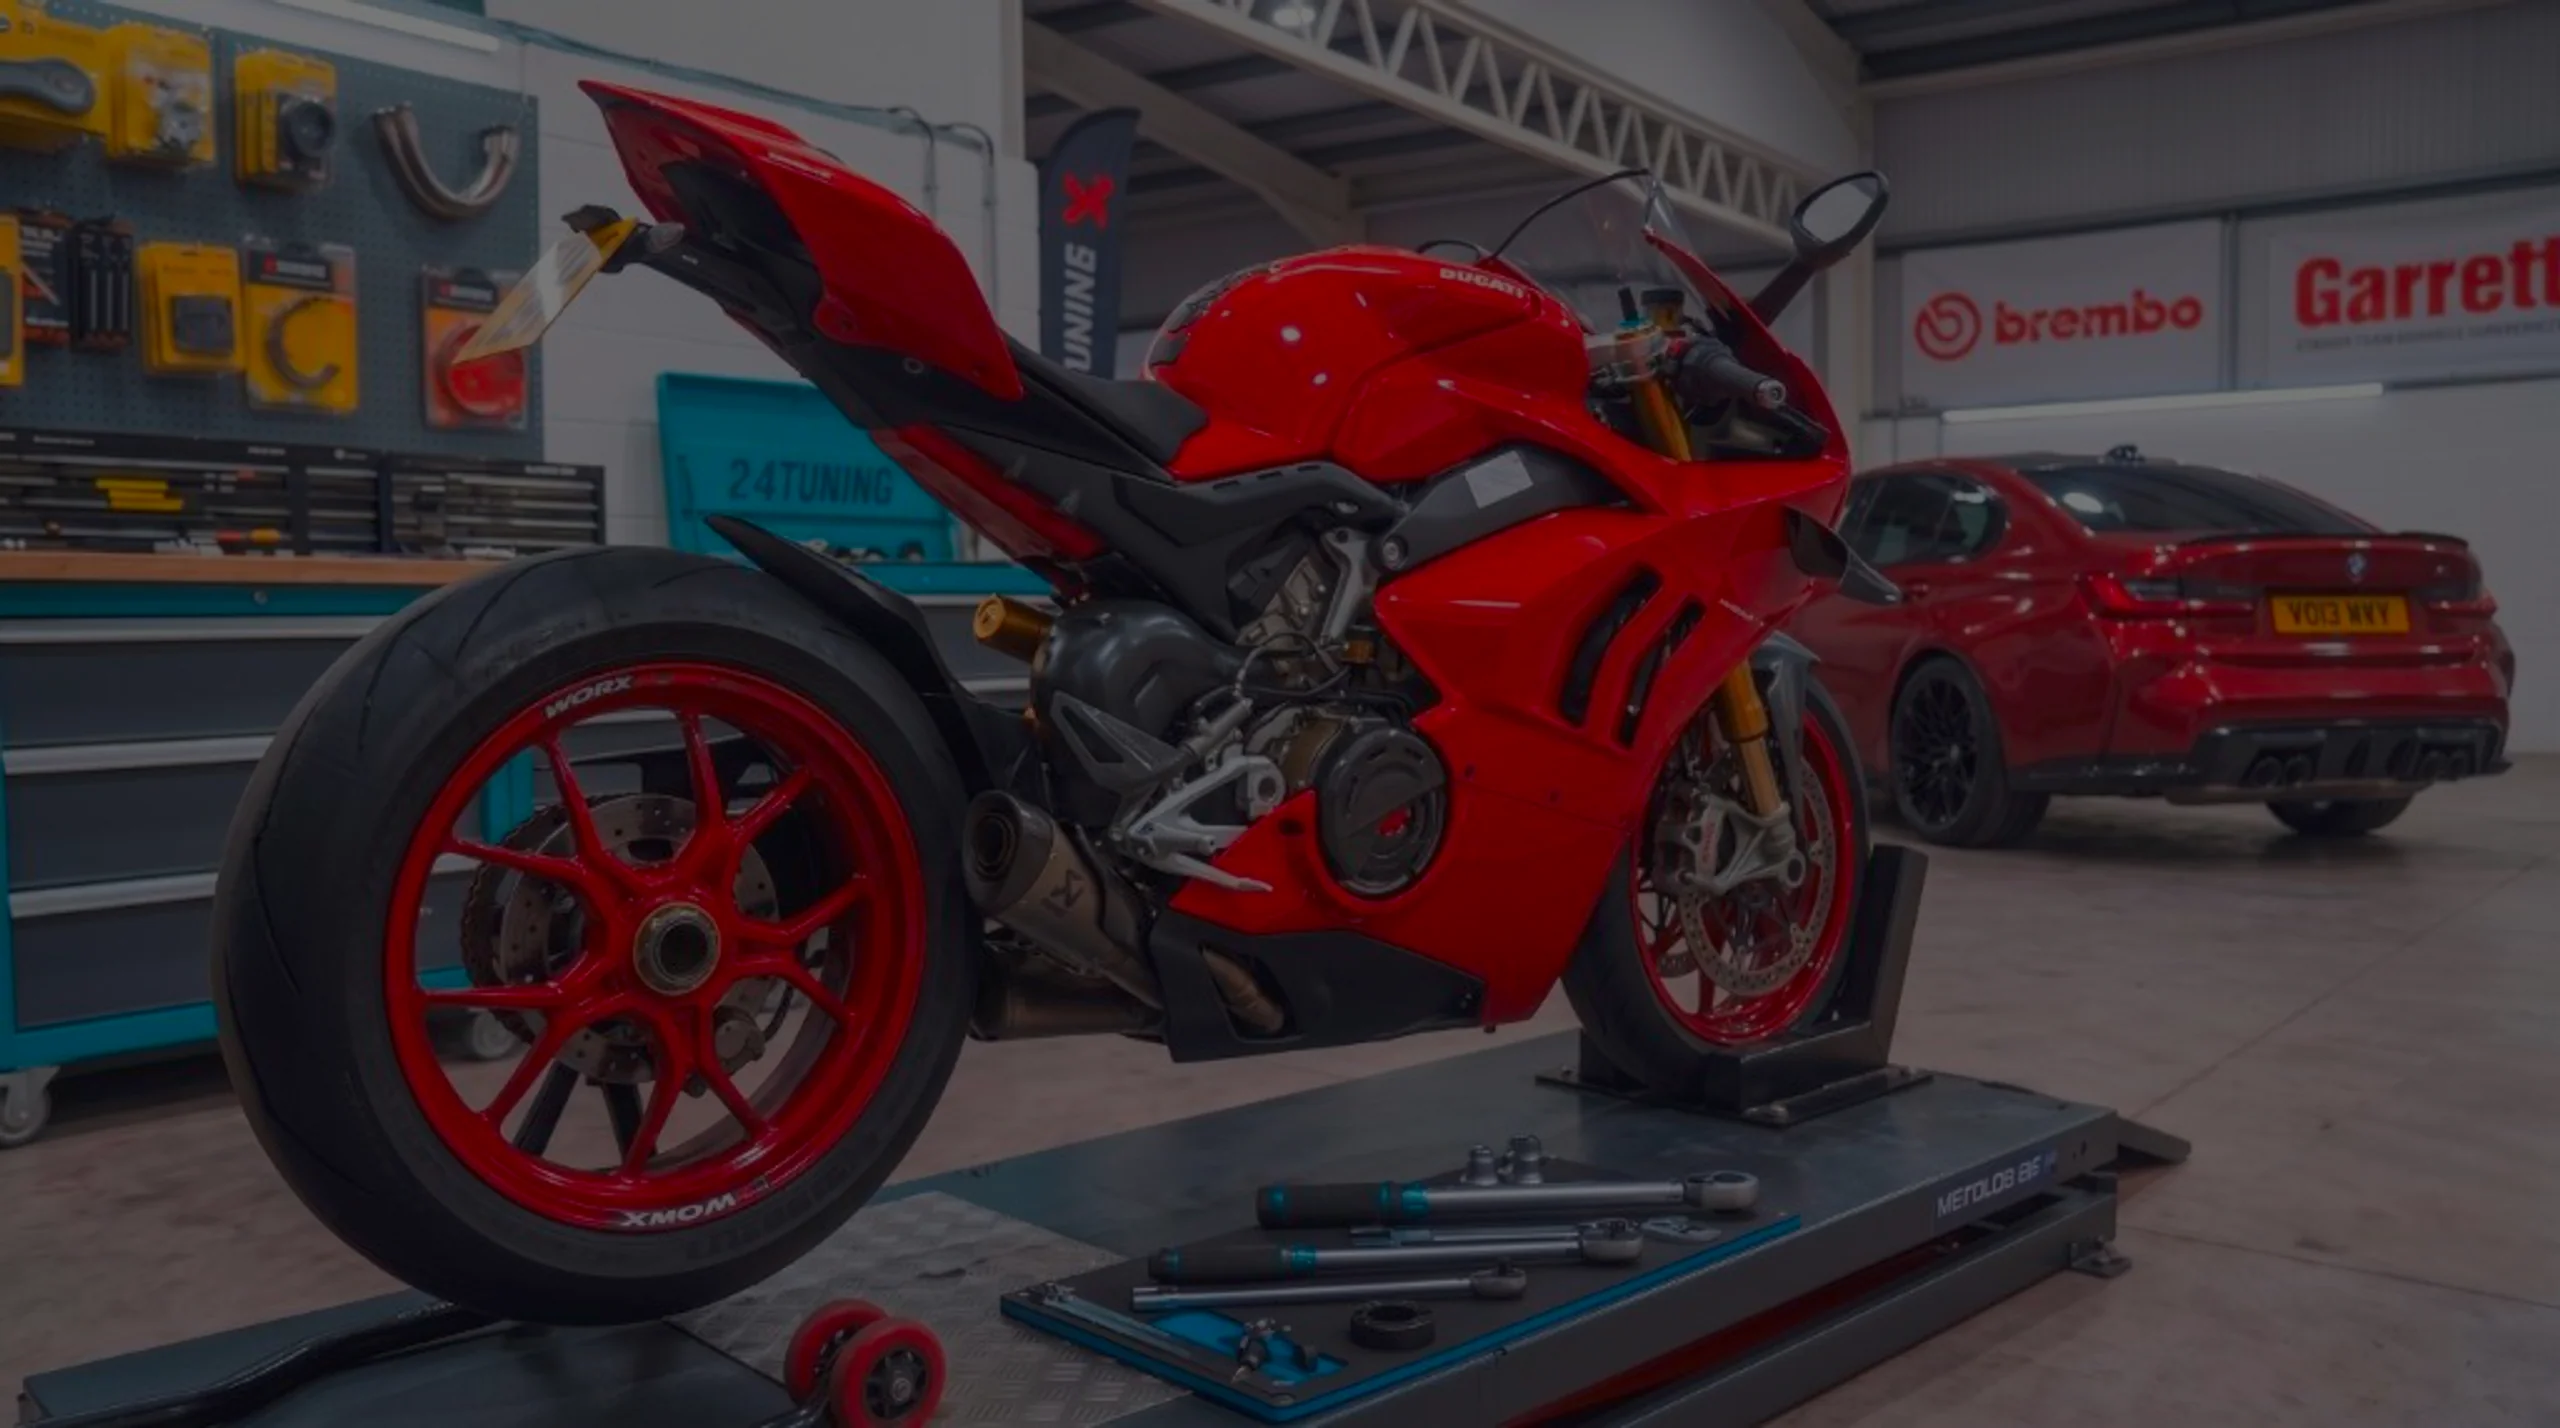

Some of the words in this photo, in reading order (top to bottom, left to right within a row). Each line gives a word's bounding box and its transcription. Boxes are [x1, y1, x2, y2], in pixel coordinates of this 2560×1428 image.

[1440, 267, 1524, 299] DUCATI
[1996, 289, 2202, 343] brembo
[729, 457, 894, 506] 24TUNING
